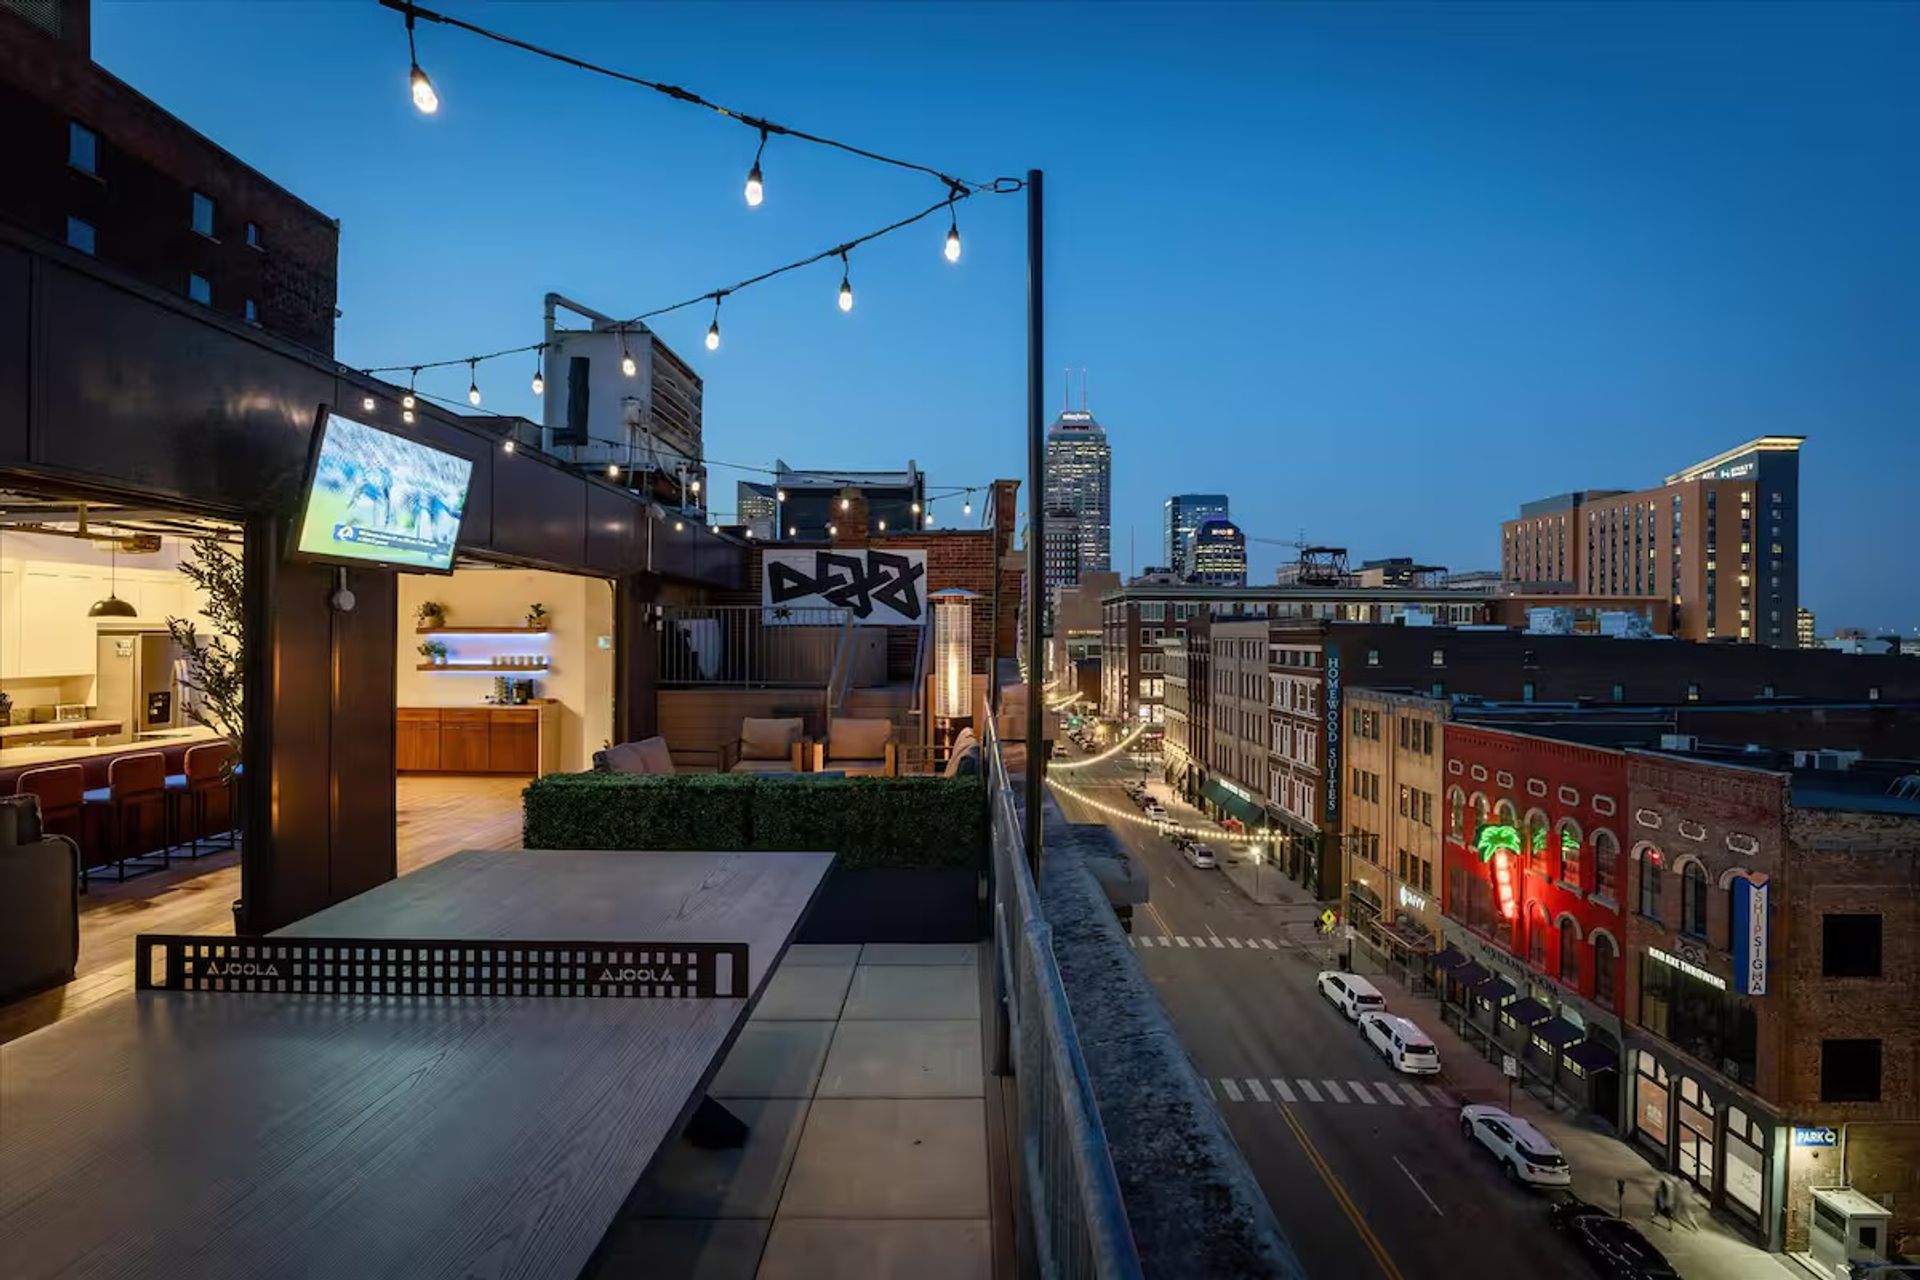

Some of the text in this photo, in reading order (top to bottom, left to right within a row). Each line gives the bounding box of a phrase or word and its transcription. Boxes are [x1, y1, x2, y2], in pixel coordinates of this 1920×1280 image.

[1327, 657, 1339, 811] HOMEWOOD SUITES
[1680, 960, 1726, 991] THROWING
[1797, 1131, 1825, 1143] PARK
